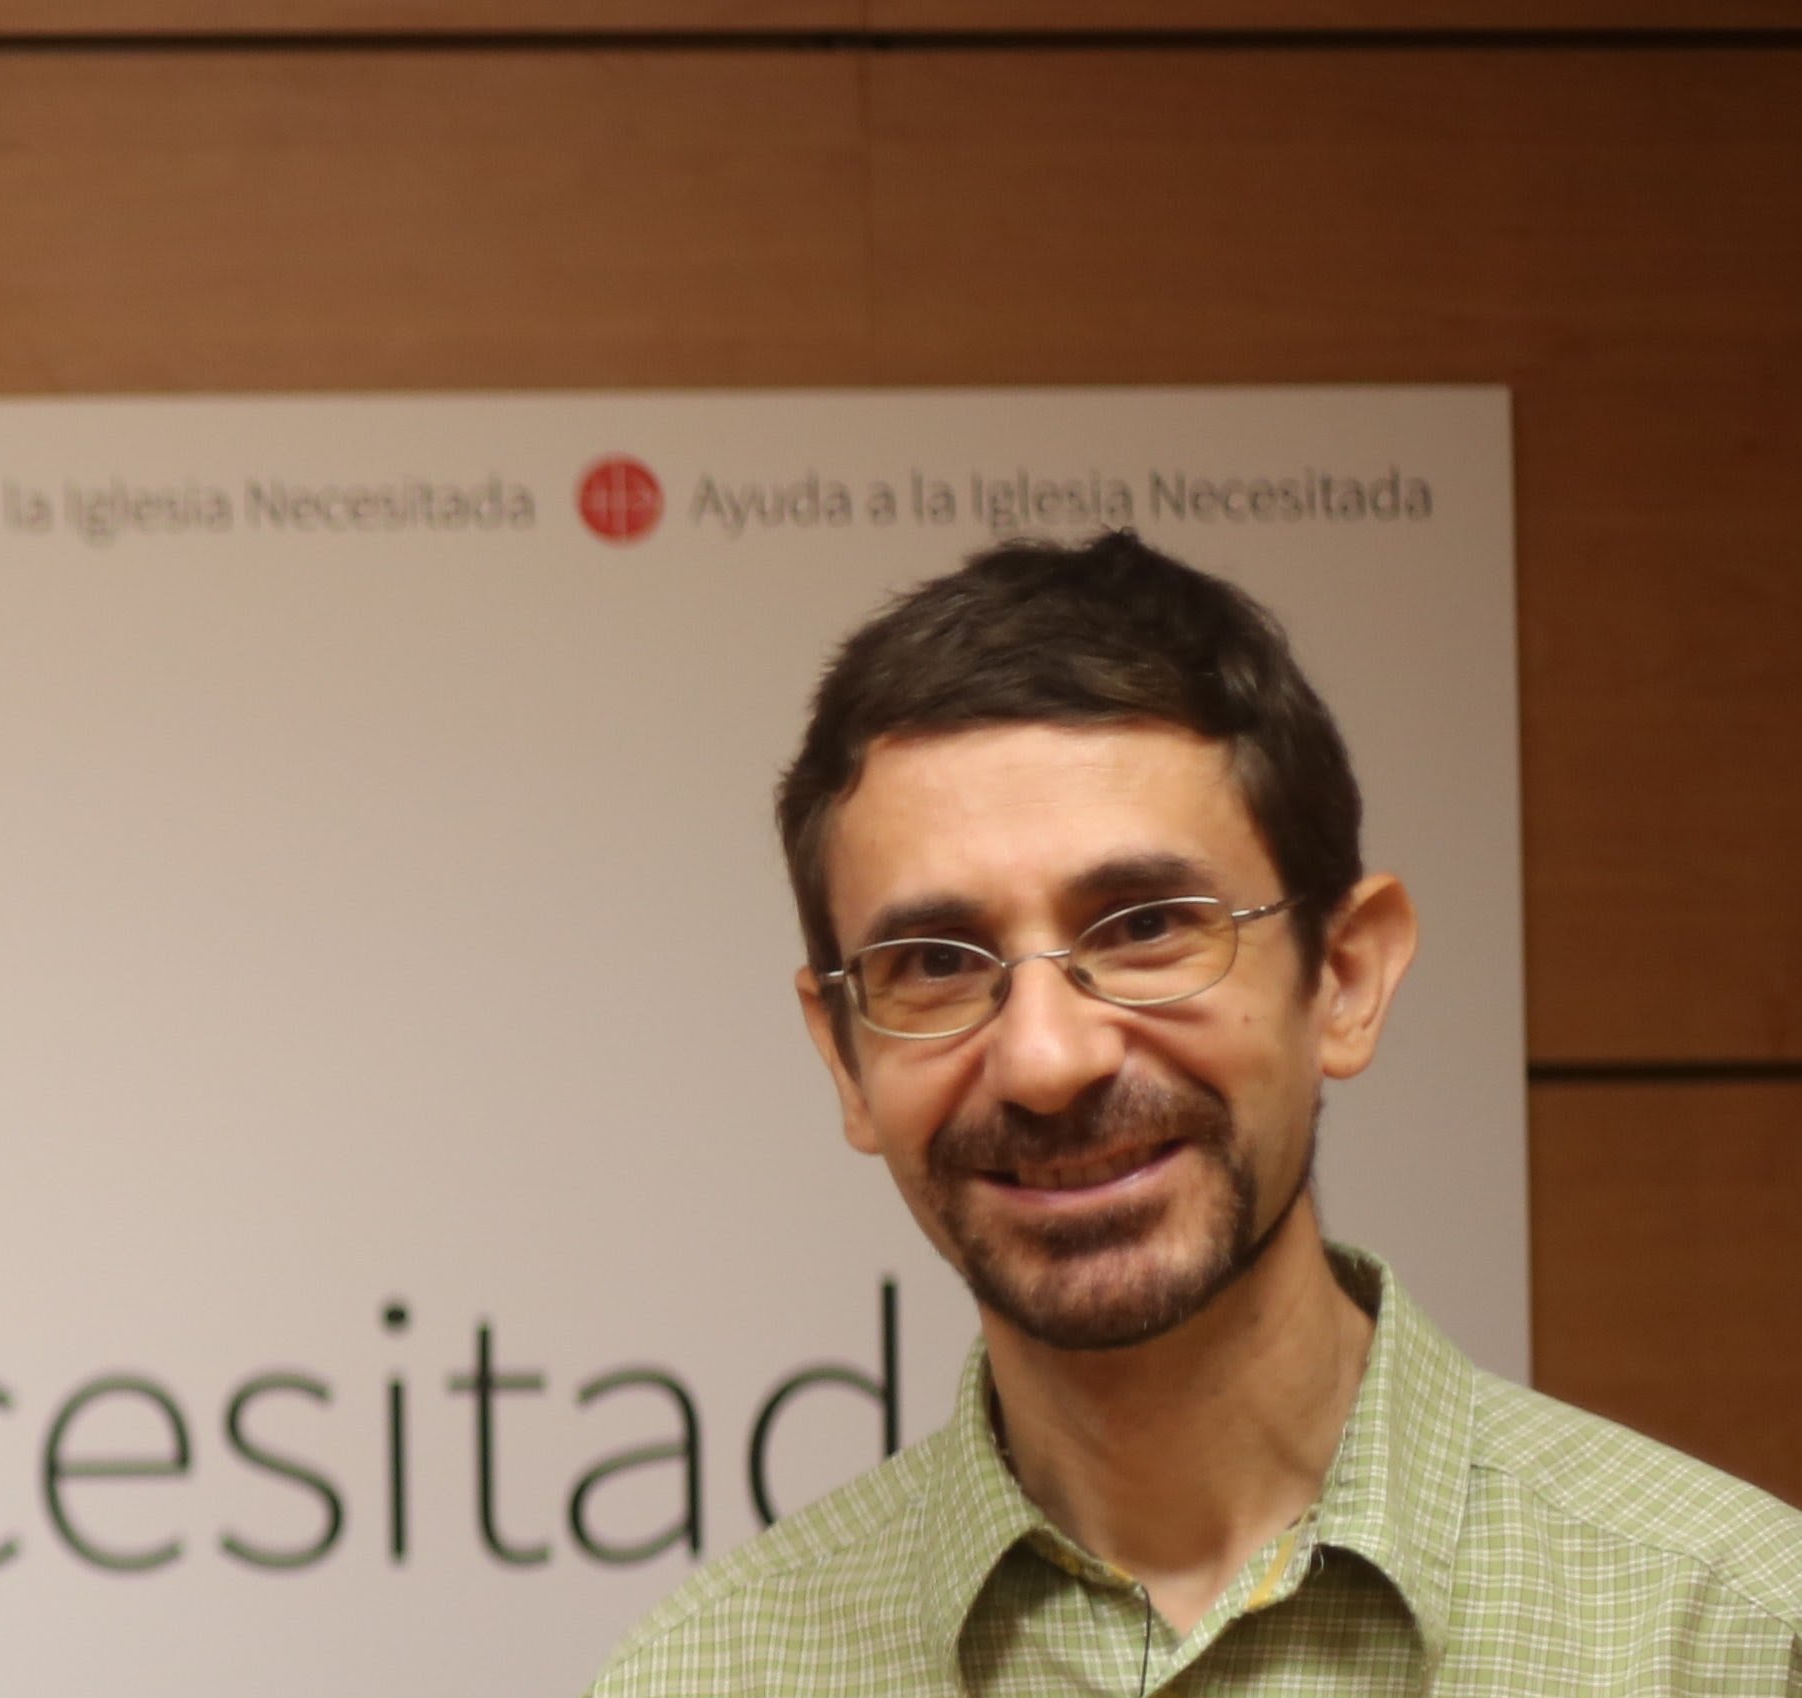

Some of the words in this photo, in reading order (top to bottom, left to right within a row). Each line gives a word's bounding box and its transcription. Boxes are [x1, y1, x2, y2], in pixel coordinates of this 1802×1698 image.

[1, 473, 55, 536] la
[63, 472, 234, 551] Iglesia
[243, 470, 537, 535] Necesitada
[689, 467, 853, 542] Ayuda
[864, 480, 899, 528] a
[910, 467, 958, 526] la
[972, 466, 1135, 536] Iglesia
[1149, 465, 1435, 525] Necesitada
